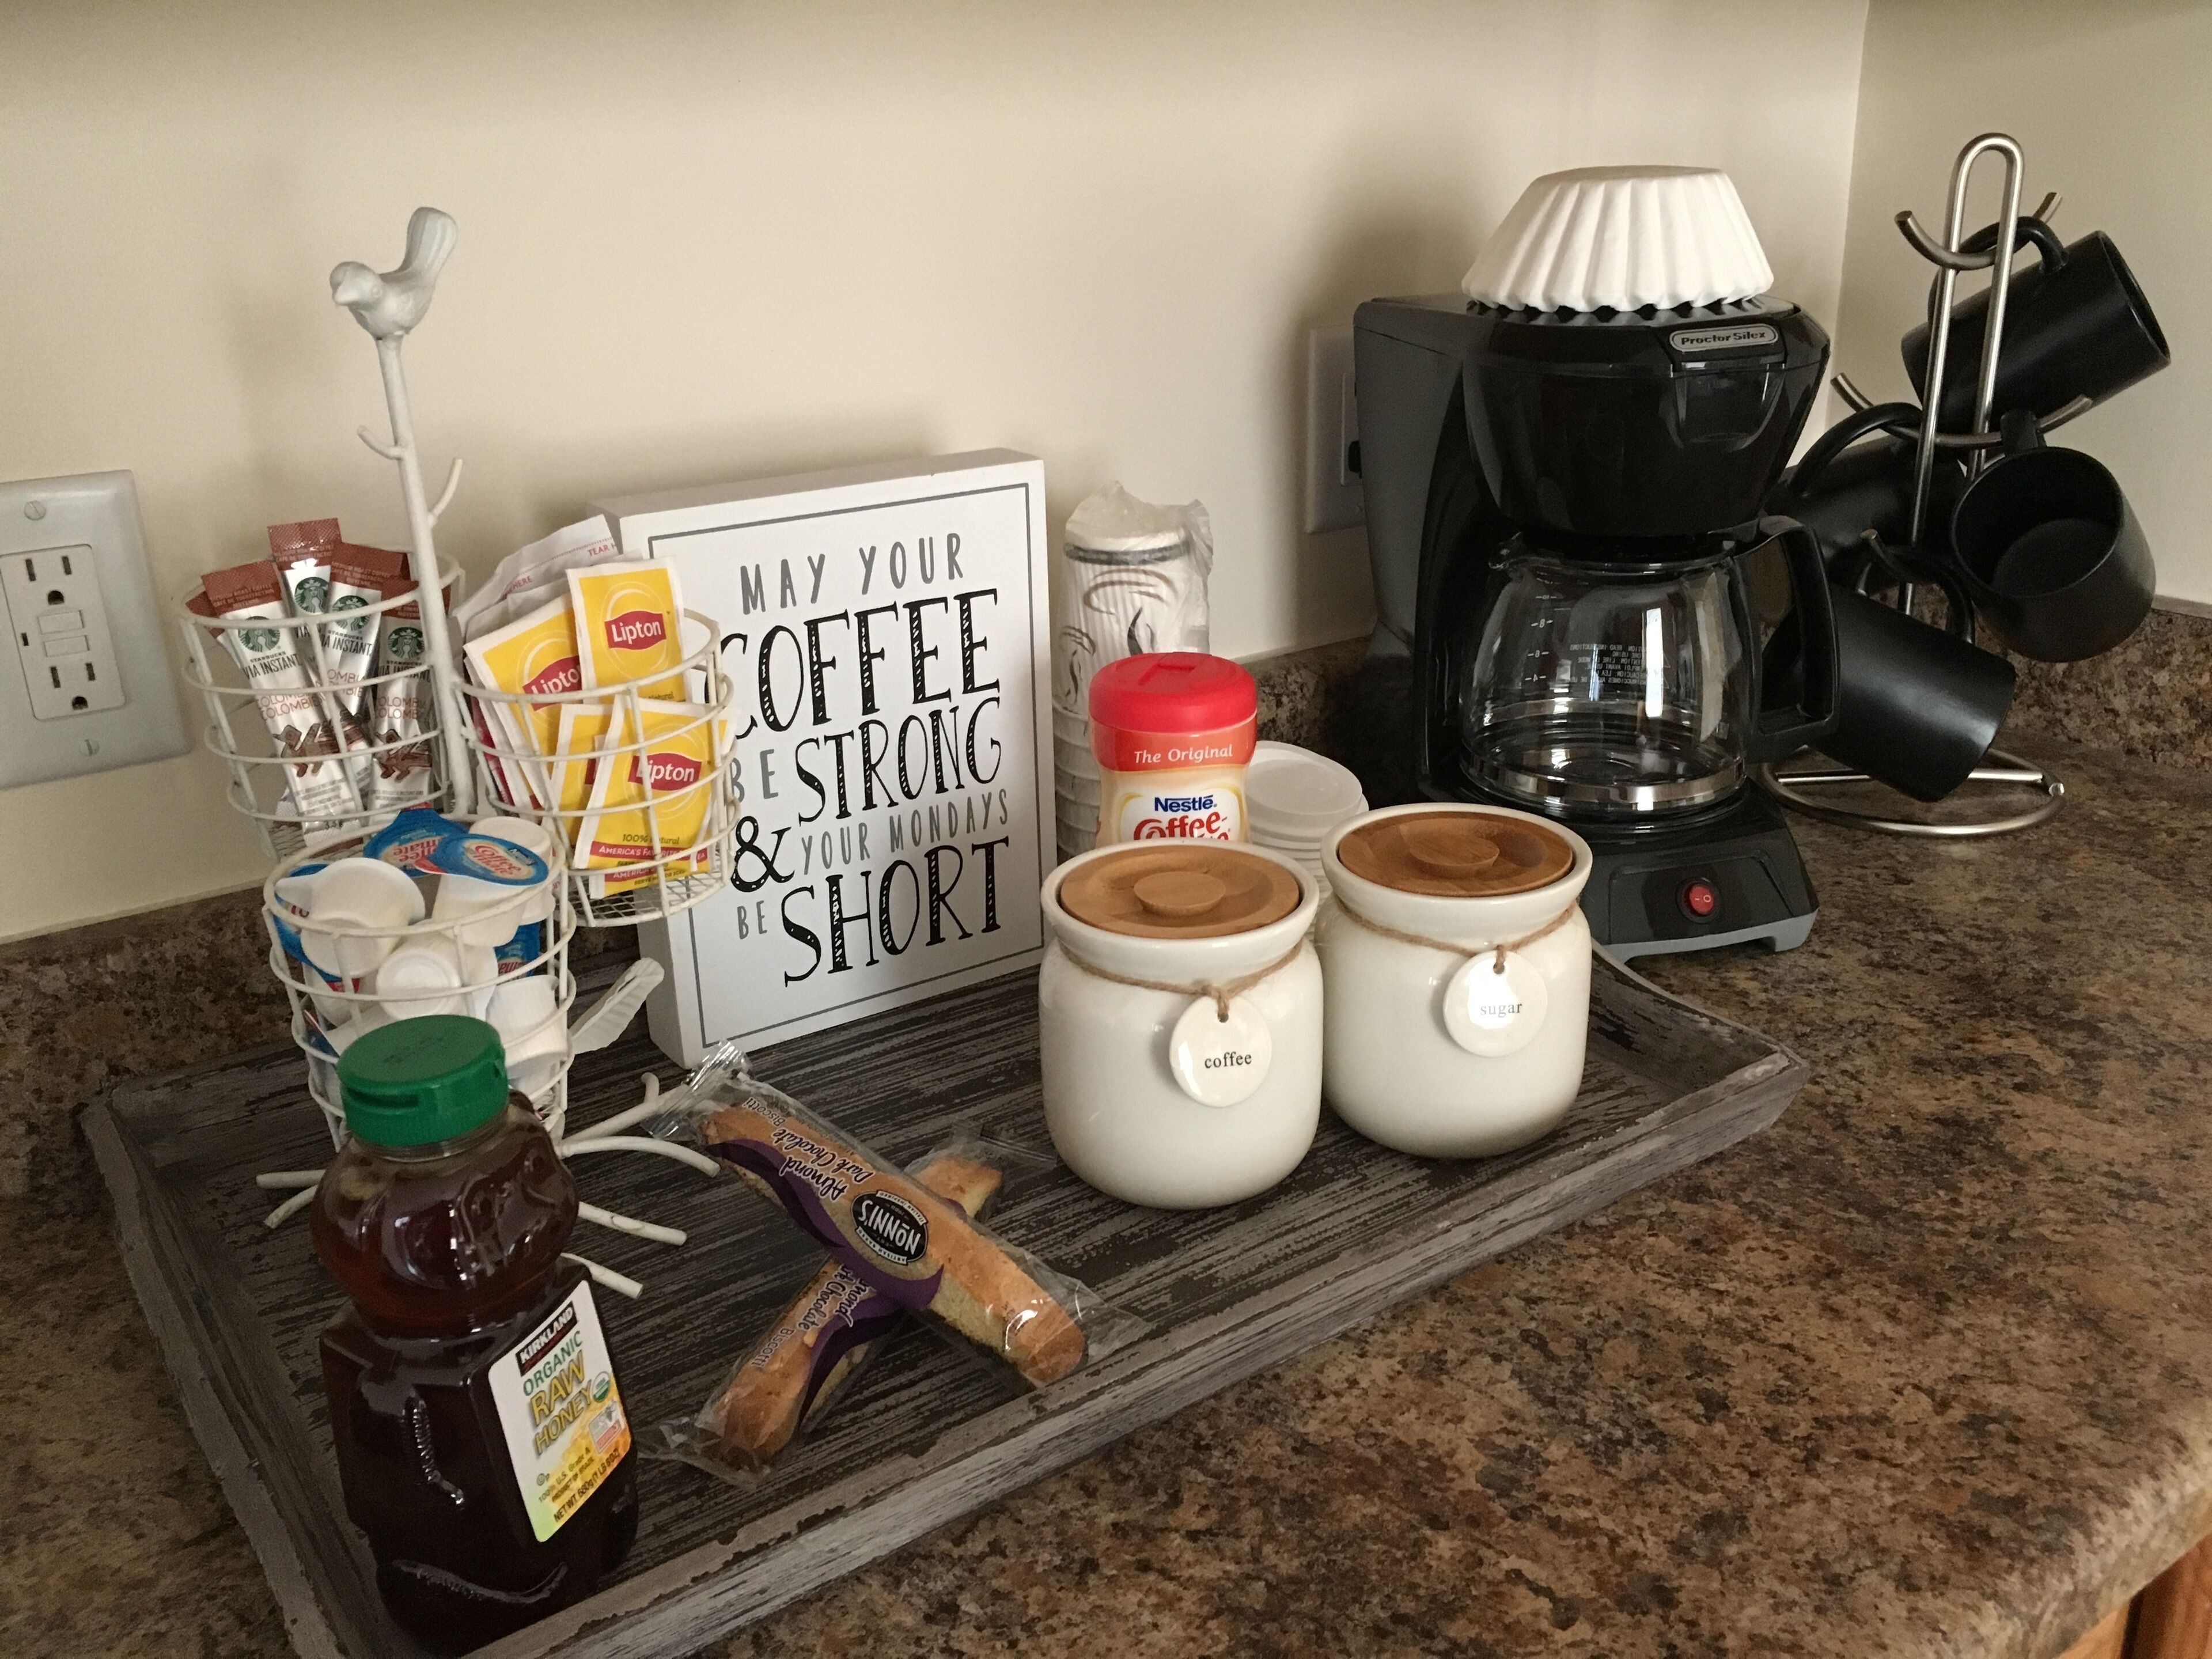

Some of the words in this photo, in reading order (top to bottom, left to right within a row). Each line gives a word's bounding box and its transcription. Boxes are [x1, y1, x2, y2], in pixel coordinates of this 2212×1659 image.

[1681, 335, 1731, 345] Proctor
[1733, 331, 1766, 340] Silex
[587, 544, 609, 556] TEAR
[513, 576, 532, 589] HERE
[740, 554, 825, 615] MAY
[859, 533, 963, 595] YOUR
[328, 630, 363, 641] STARBUCKS
[332, 637, 373, 656] INSTANT
[611, 621, 661, 645] Lipton
[243, 664, 260, 680] VIA
[261, 653, 302, 675] INSTANT
[250, 651, 286, 663] STARBUCKS
[705, 588, 1000, 739] COFFEE
[531, 665, 581, 694] Lipto
[730, 749, 779, 802] BE
[796, 696, 1001, 827] STRONG
[1134, 751, 1161, 763] The
[1168, 744, 1233, 763] Original
[393, 840, 436, 855] mate
[599, 846, 641, 856] AMERICA'S
[623, 834, 648, 843] 100%
[730, 816, 795, 892] &
[801, 823, 870, 874] YOUR
[889, 789, 1007, 853] MONDAYS
[737, 900, 767, 939] BE
[781, 836, 1009, 987] SHORT
[1480, 1003, 1522, 1018] sugar
[1205, 1051, 1252, 1069] coffee
[743, 1097, 786, 1127] Biscotti
[773, 1128, 836, 1167] Chocolate
[779, 1156, 847, 1200] Almond
[831, 1158, 874, 1183] Dark
[858, 1200, 921, 1255] NONNI'S
[797, 1281, 846, 1331] Chocolate
[520, 1307, 573, 1364] KIRKLAND
[751, 1327, 796, 1371] Biscotti
[523, 1330, 582, 1396] ORGANIC
[530, 1349, 584, 1427] RAW
[535, 1379, 592, 1456] HONEY
[554, 1504, 568, 1522] NET
